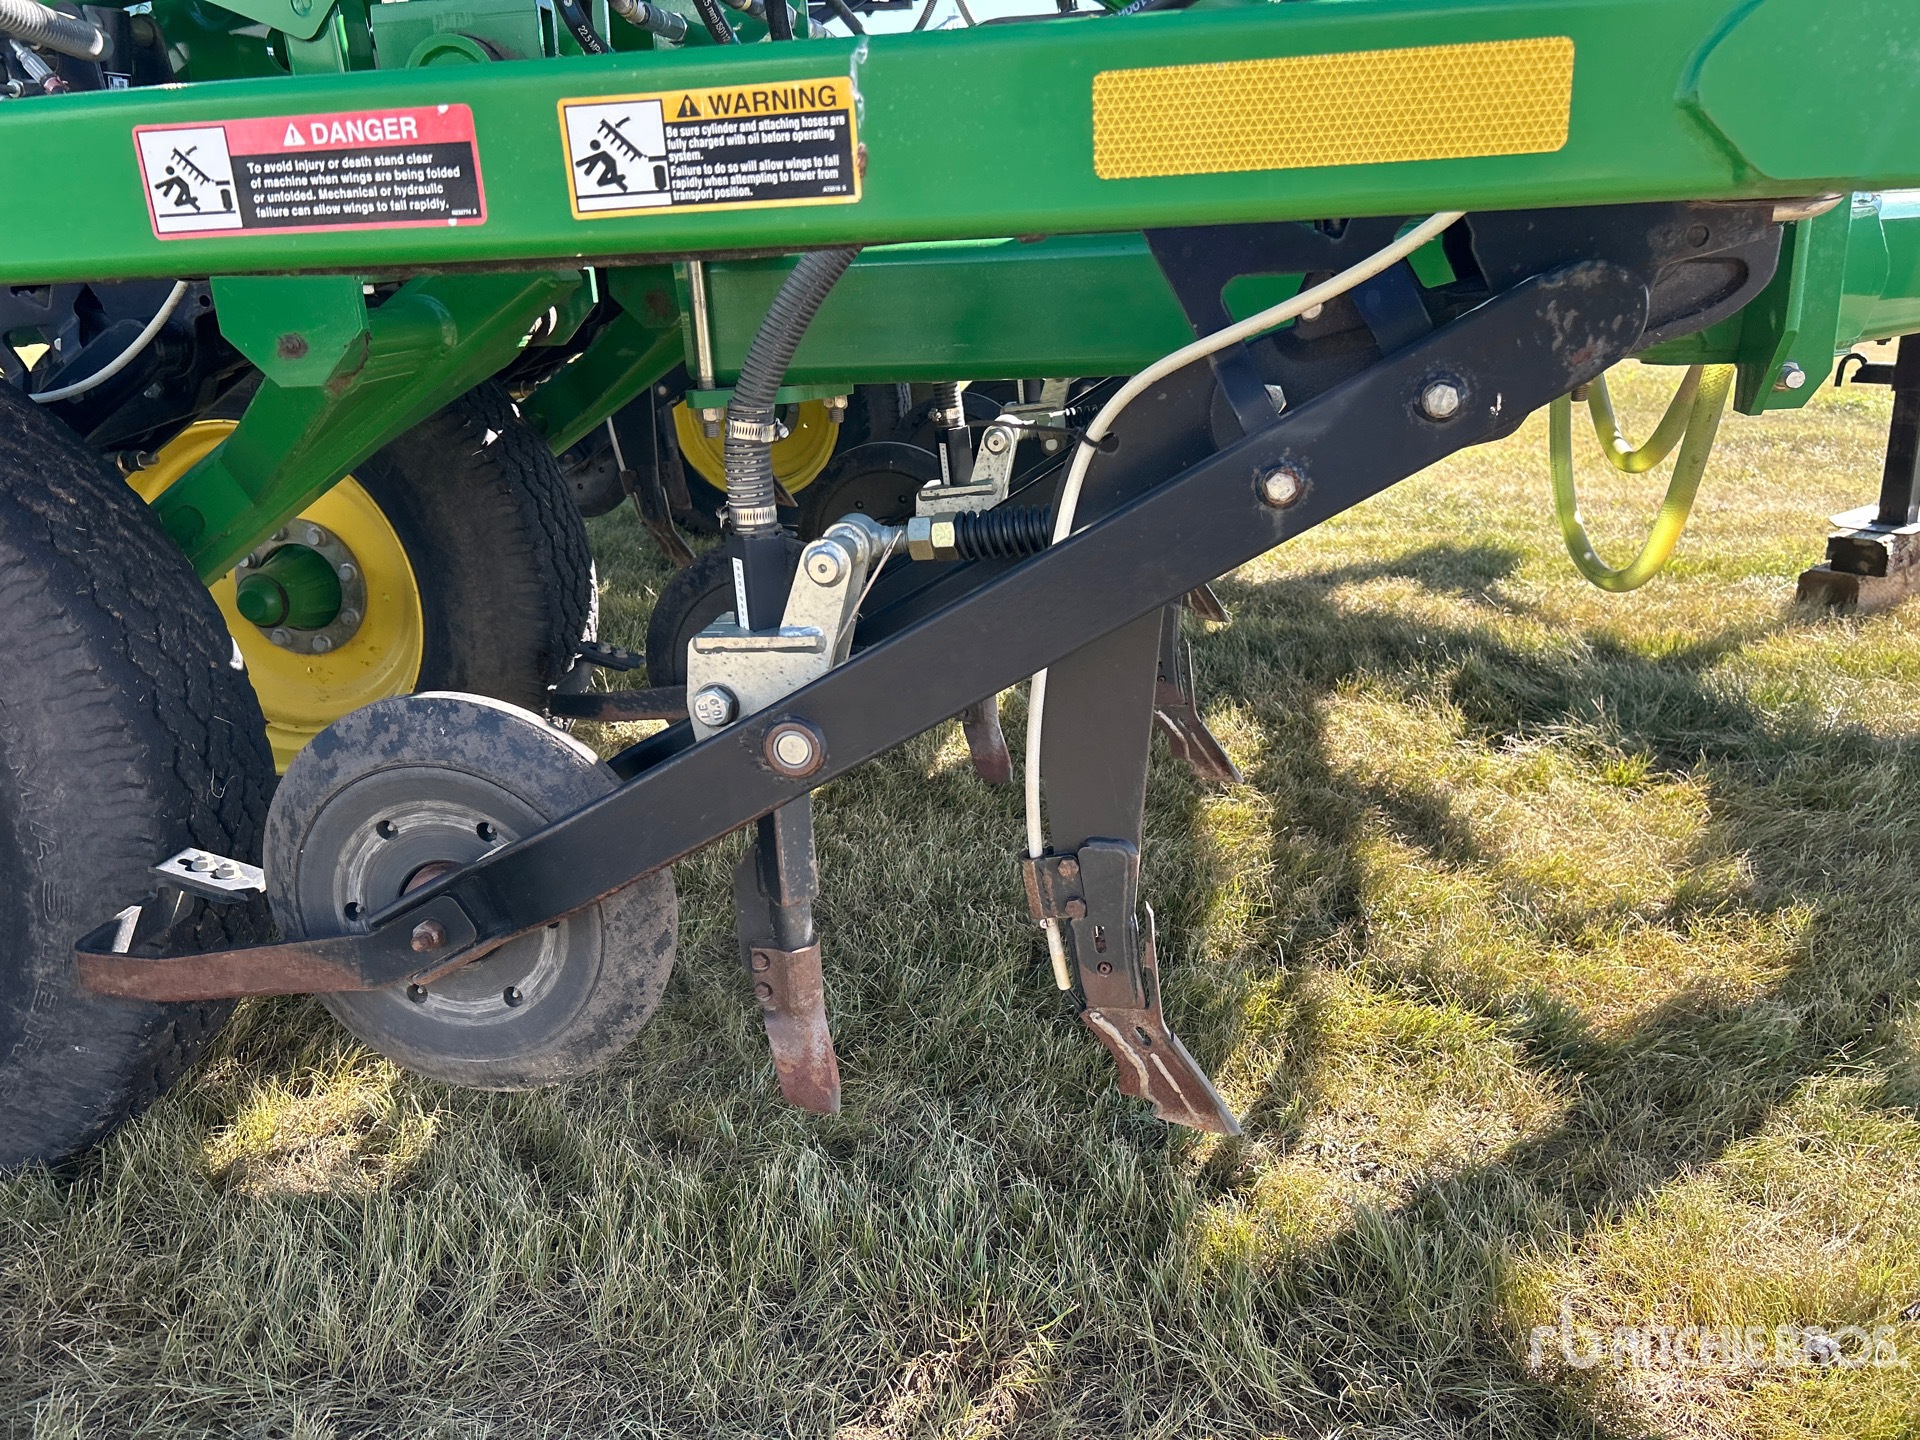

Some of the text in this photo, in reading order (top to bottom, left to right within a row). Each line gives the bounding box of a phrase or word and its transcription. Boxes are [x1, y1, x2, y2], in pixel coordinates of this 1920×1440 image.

[708, 85, 837, 115] WARNING
[310, 117, 418, 146] DANGER
[666, 115, 845, 138] Be sure cylinder and attaching hoses are
[667, 128, 835, 151] fully charged with oil before operating
[247, 152, 433, 174] To avoid injury or death stand clear
[668, 151, 704, 164] system.
[670, 154, 839, 177] Failure to do so will allow wings to fall
[250, 166, 461, 189] of machine when wings are being folded
[671, 168, 839, 190] rapidly when attempting to lower from
[253, 183, 444, 204] or unfolded. Mechanical or hydraulic
[673, 186, 753, 201] transport position.
[256, 203, 290, 219] failure
[291, 205, 311, 217] can
[313, 203, 341, 215] allow
[343, 201, 374, 215] wings
[377, 201, 388, 212] to
[390, 199, 407, 211] fall
[409, 197, 449, 212] rapidly.
[710, 699, 723, 720] 10.9
